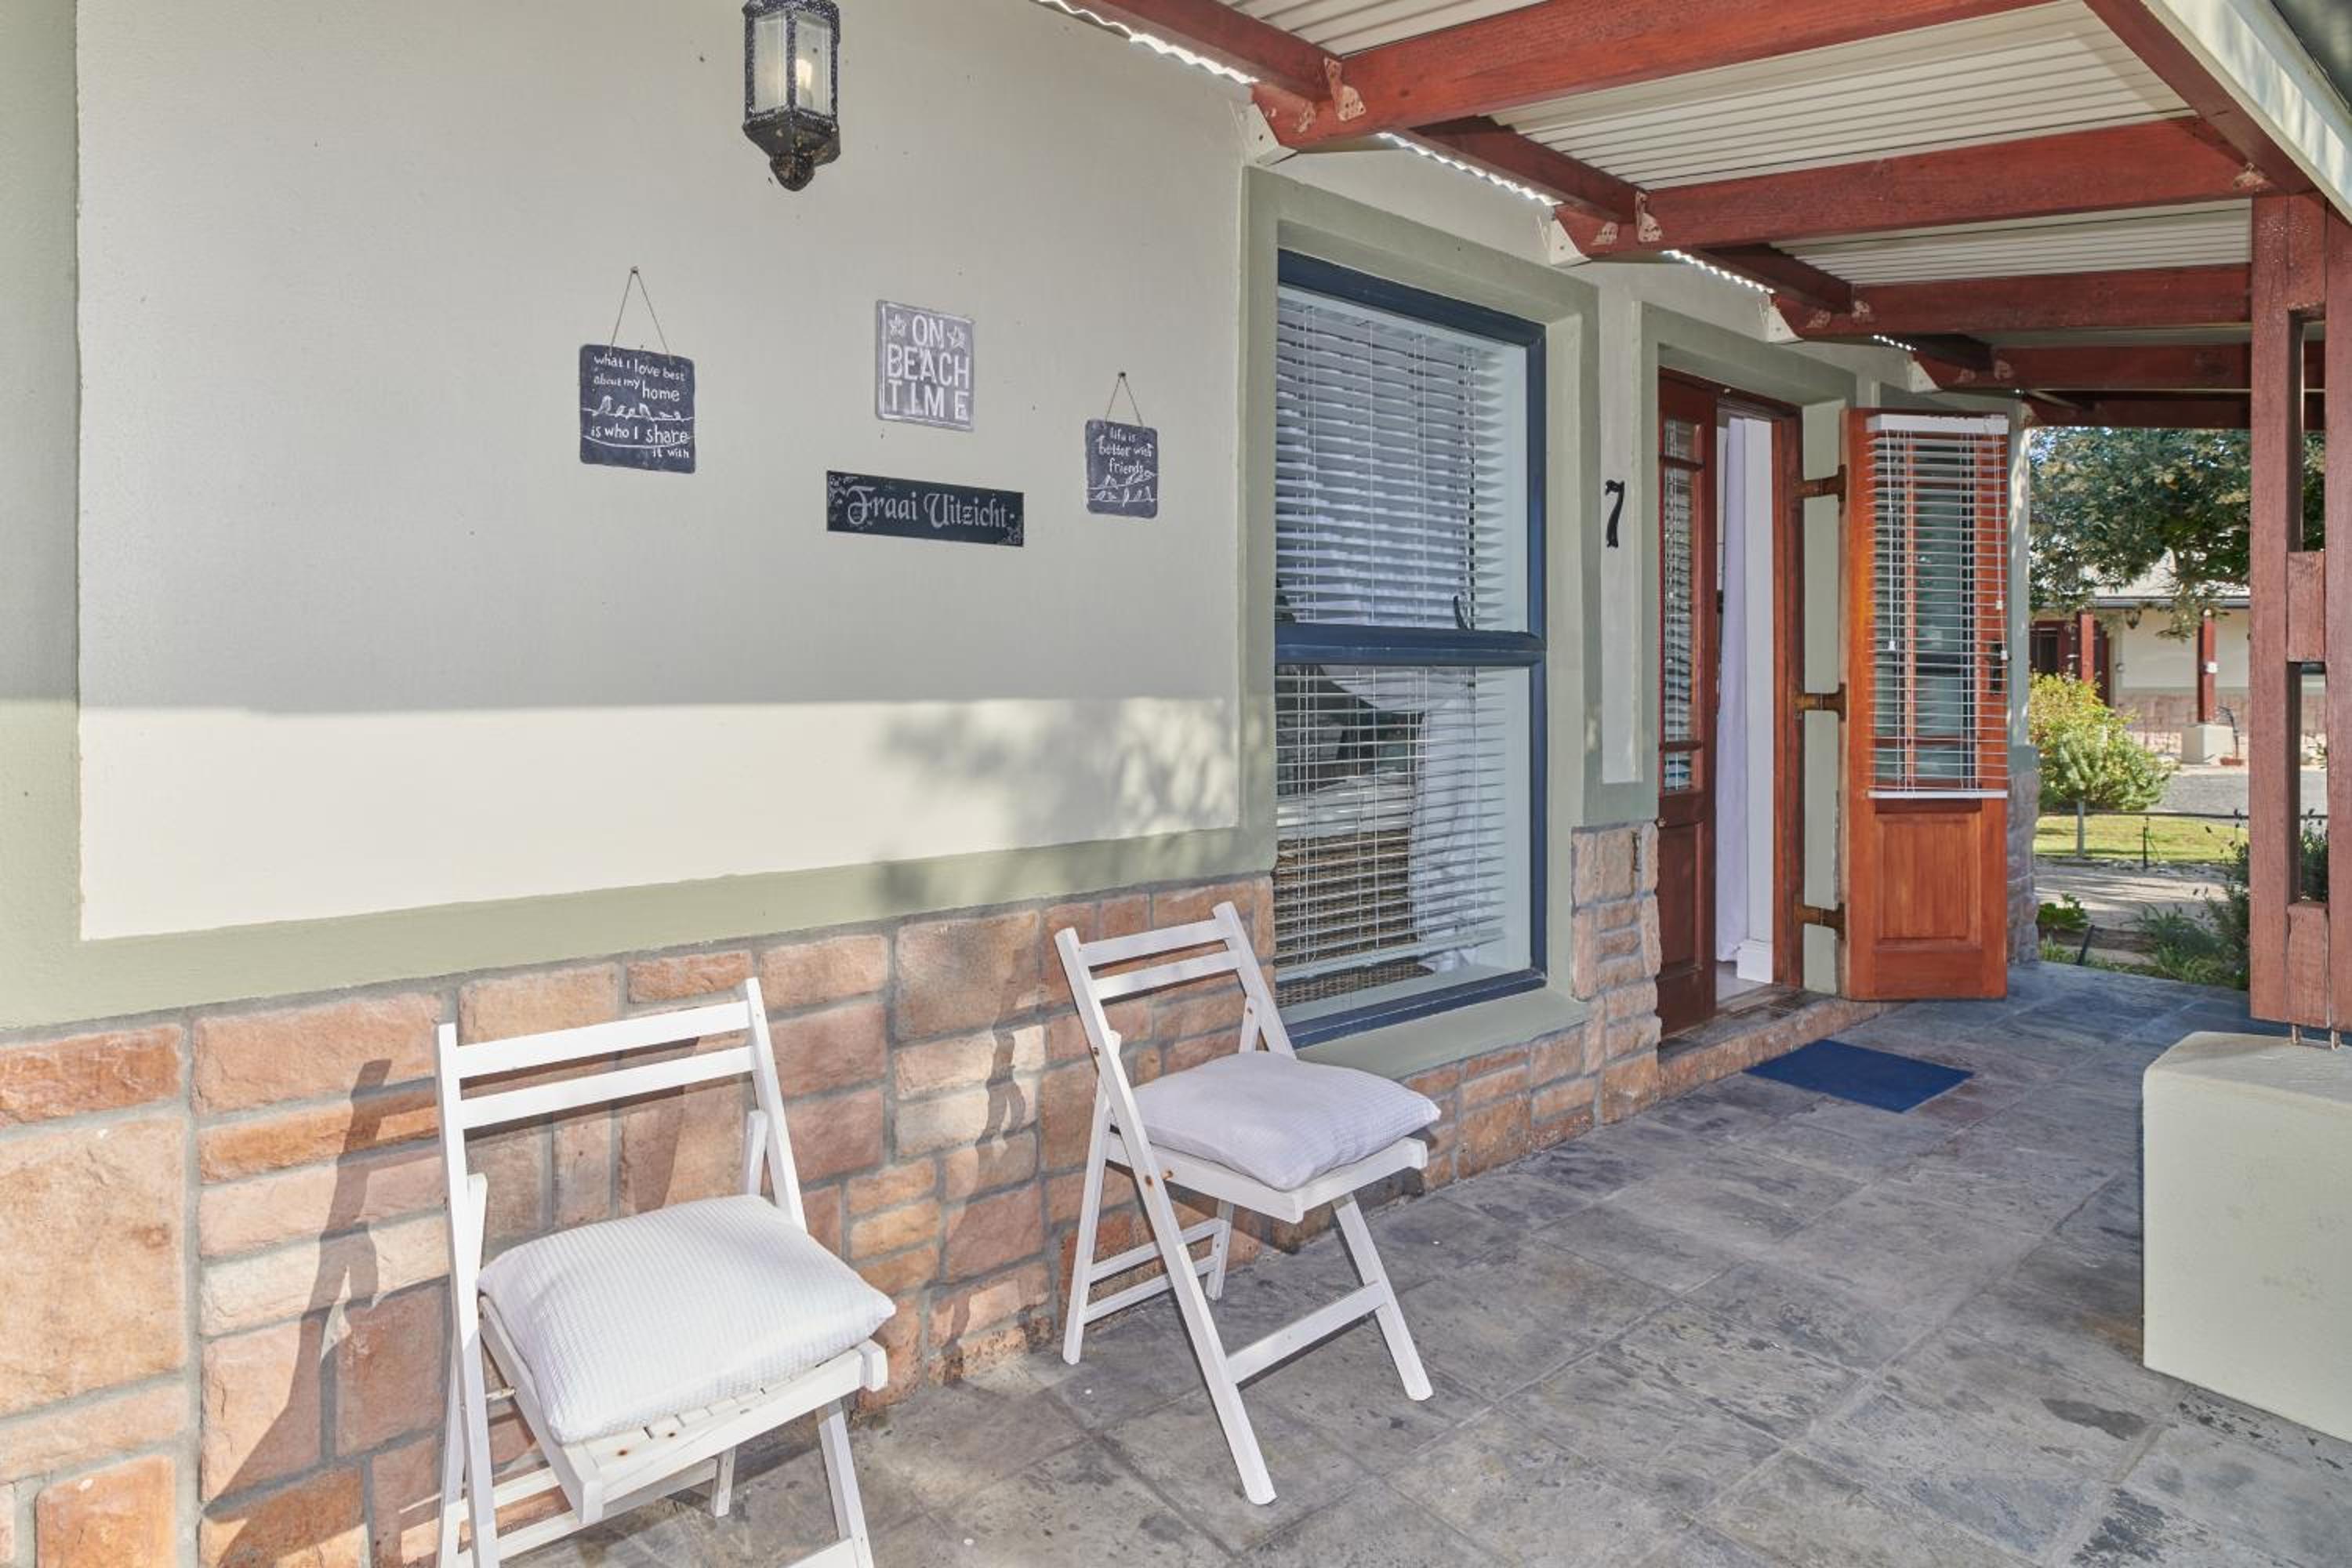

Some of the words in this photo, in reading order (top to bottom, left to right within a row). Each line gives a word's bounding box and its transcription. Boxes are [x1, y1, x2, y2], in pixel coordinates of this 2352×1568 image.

[913, 314, 944, 349] ON
[593, 354, 622, 368] what
[634, 358, 660, 376] love
[662, 368, 685, 381] best
[887, 343, 969, 389] BEACH
[593, 373, 622, 387] about
[624, 379, 640, 390] my
[642, 380, 680, 401] home
[887, 379, 969, 420] TIME
[591, 426, 601, 437] is
[604, 423, 630, 438] who
[634, 426, 638, 440] I
[646, 424, 688, 444] share
[652, 448, 662, 458] it
[667, 448, 689, 459] with
[1109, 457, 1144, 474] friends
[846, 485, 918, 525] Fraai
[924, 492, 1007, 528] Uitzicht
[1605, 479, 1625, 548] 7
